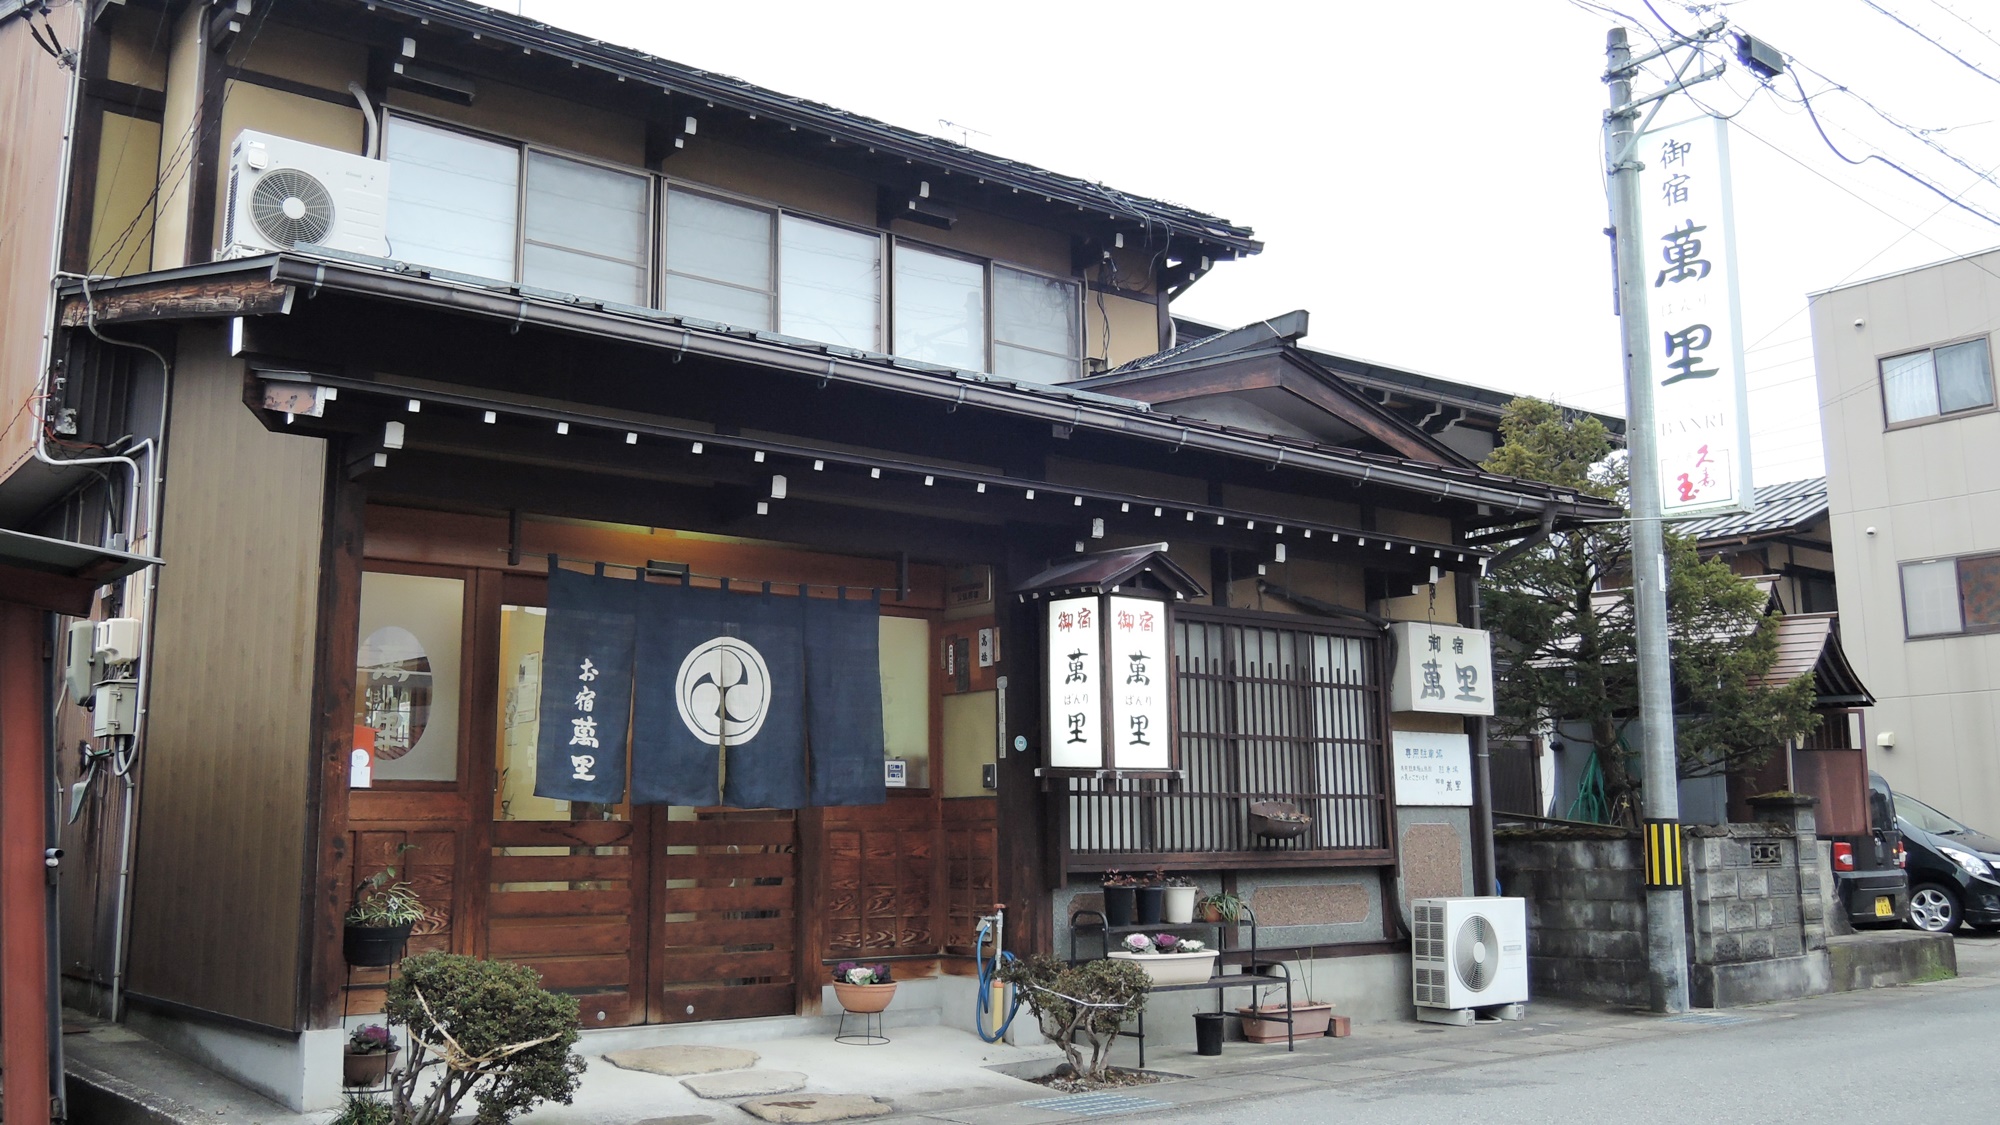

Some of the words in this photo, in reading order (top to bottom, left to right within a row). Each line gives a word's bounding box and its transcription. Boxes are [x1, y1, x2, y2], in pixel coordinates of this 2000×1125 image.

[1661, 139, 1692, 207] 御宿
[1058, 607, 1092, 633] 御宿
[1117, 610, 1154, 632] 御宿
[1428, 634, 1464, 655] 御宿
[1420, 660, 1485, 703] 萬里
